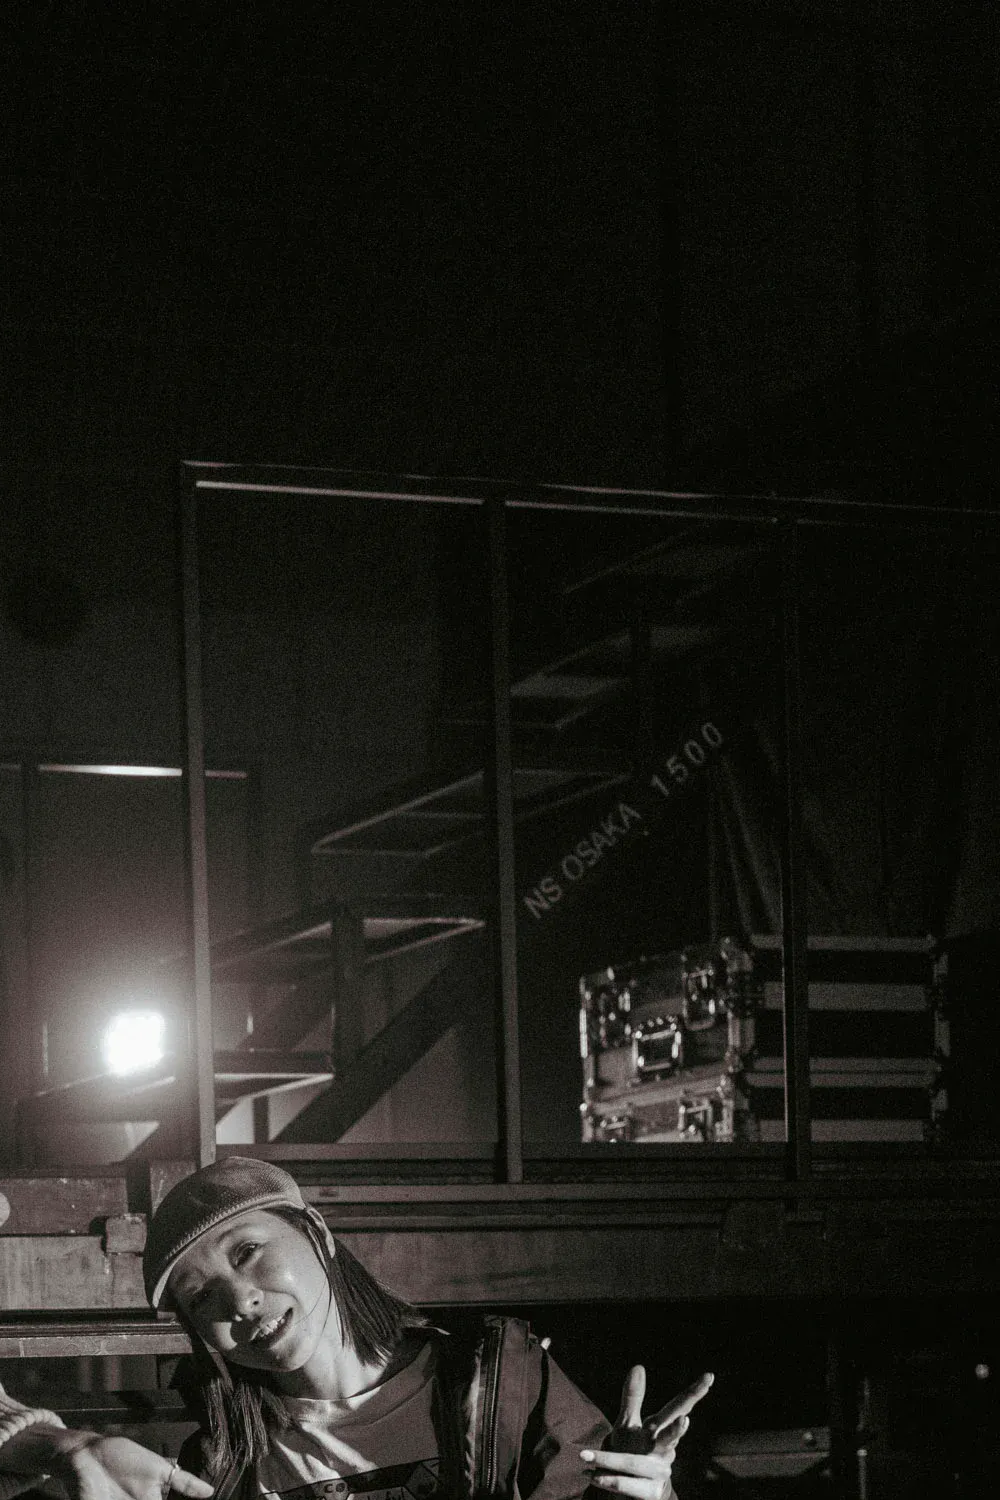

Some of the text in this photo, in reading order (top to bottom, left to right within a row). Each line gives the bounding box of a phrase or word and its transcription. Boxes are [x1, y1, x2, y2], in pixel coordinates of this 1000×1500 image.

[523, 721, 723, 919] NS OSAKA 1500
